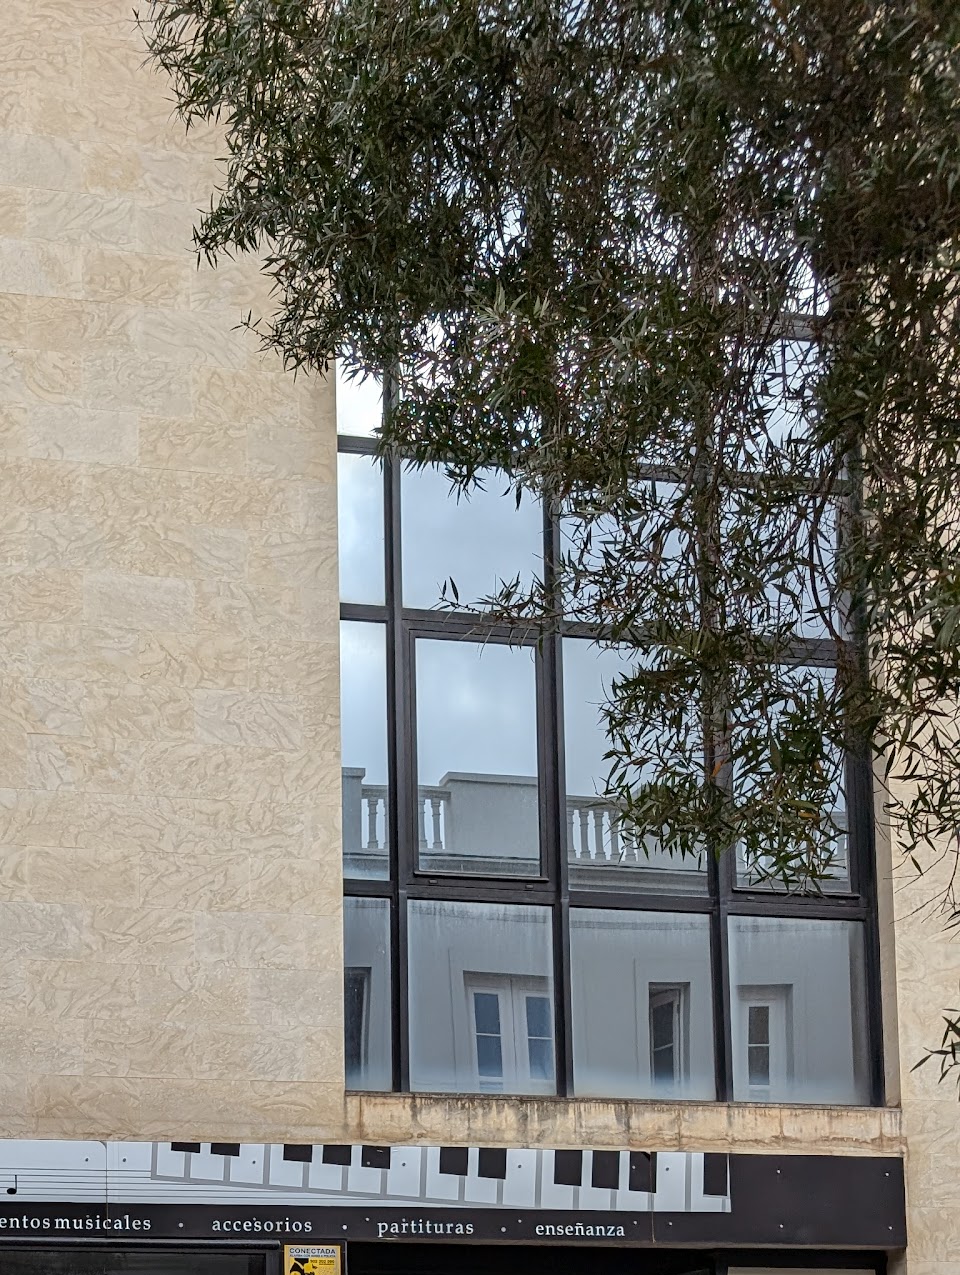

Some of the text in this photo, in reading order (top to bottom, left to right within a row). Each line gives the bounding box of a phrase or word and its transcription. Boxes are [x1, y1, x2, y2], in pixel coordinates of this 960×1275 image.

[54, 1214, 152, 1231] musicales
[211, 1216, 313, 1233] accesorios
[376, 1218, 475, 1238] partituras
[535, 1222, 626, 1237] enseñanza
